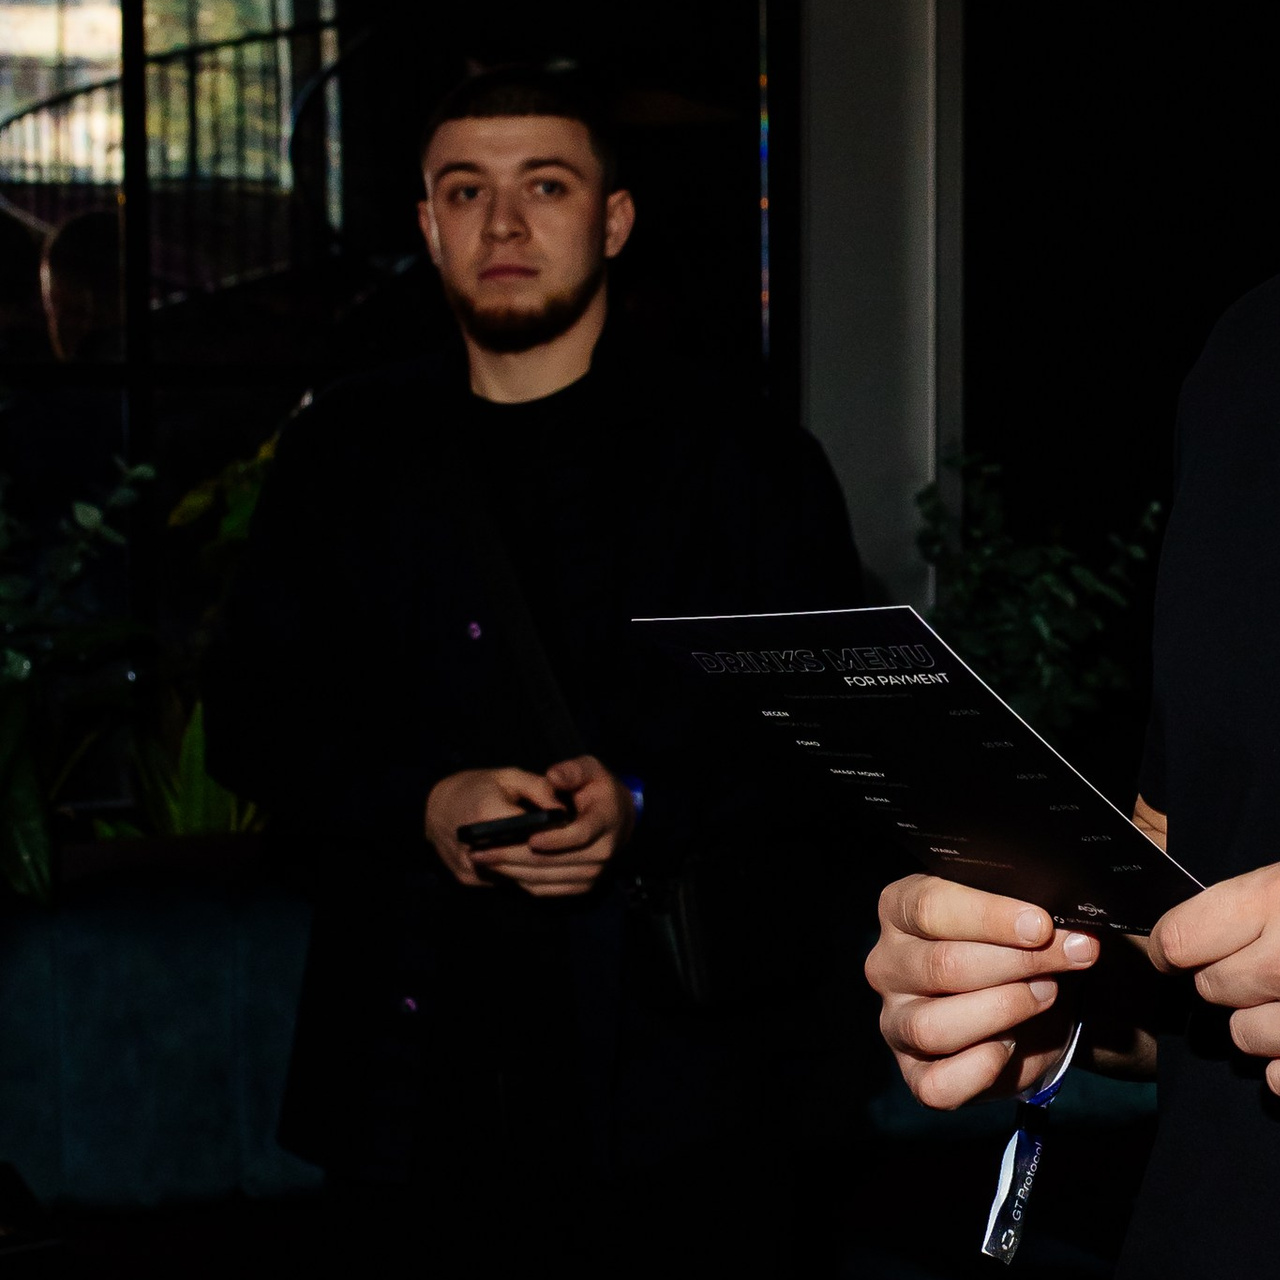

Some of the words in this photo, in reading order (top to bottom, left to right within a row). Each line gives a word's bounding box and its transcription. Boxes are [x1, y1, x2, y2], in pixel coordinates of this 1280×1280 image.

[691, 649, 826, 674] DRINKS
[822, 644, 936, 672] MENU
[843, 675, 877, 687] FOR
[877, 672, 950, 686] PAYMENT
[795, 739, 821, 747] FOMO
[1017, 1141, 1043, 1200] Protocol
[1012, 1199, 1024, 1221] GT
